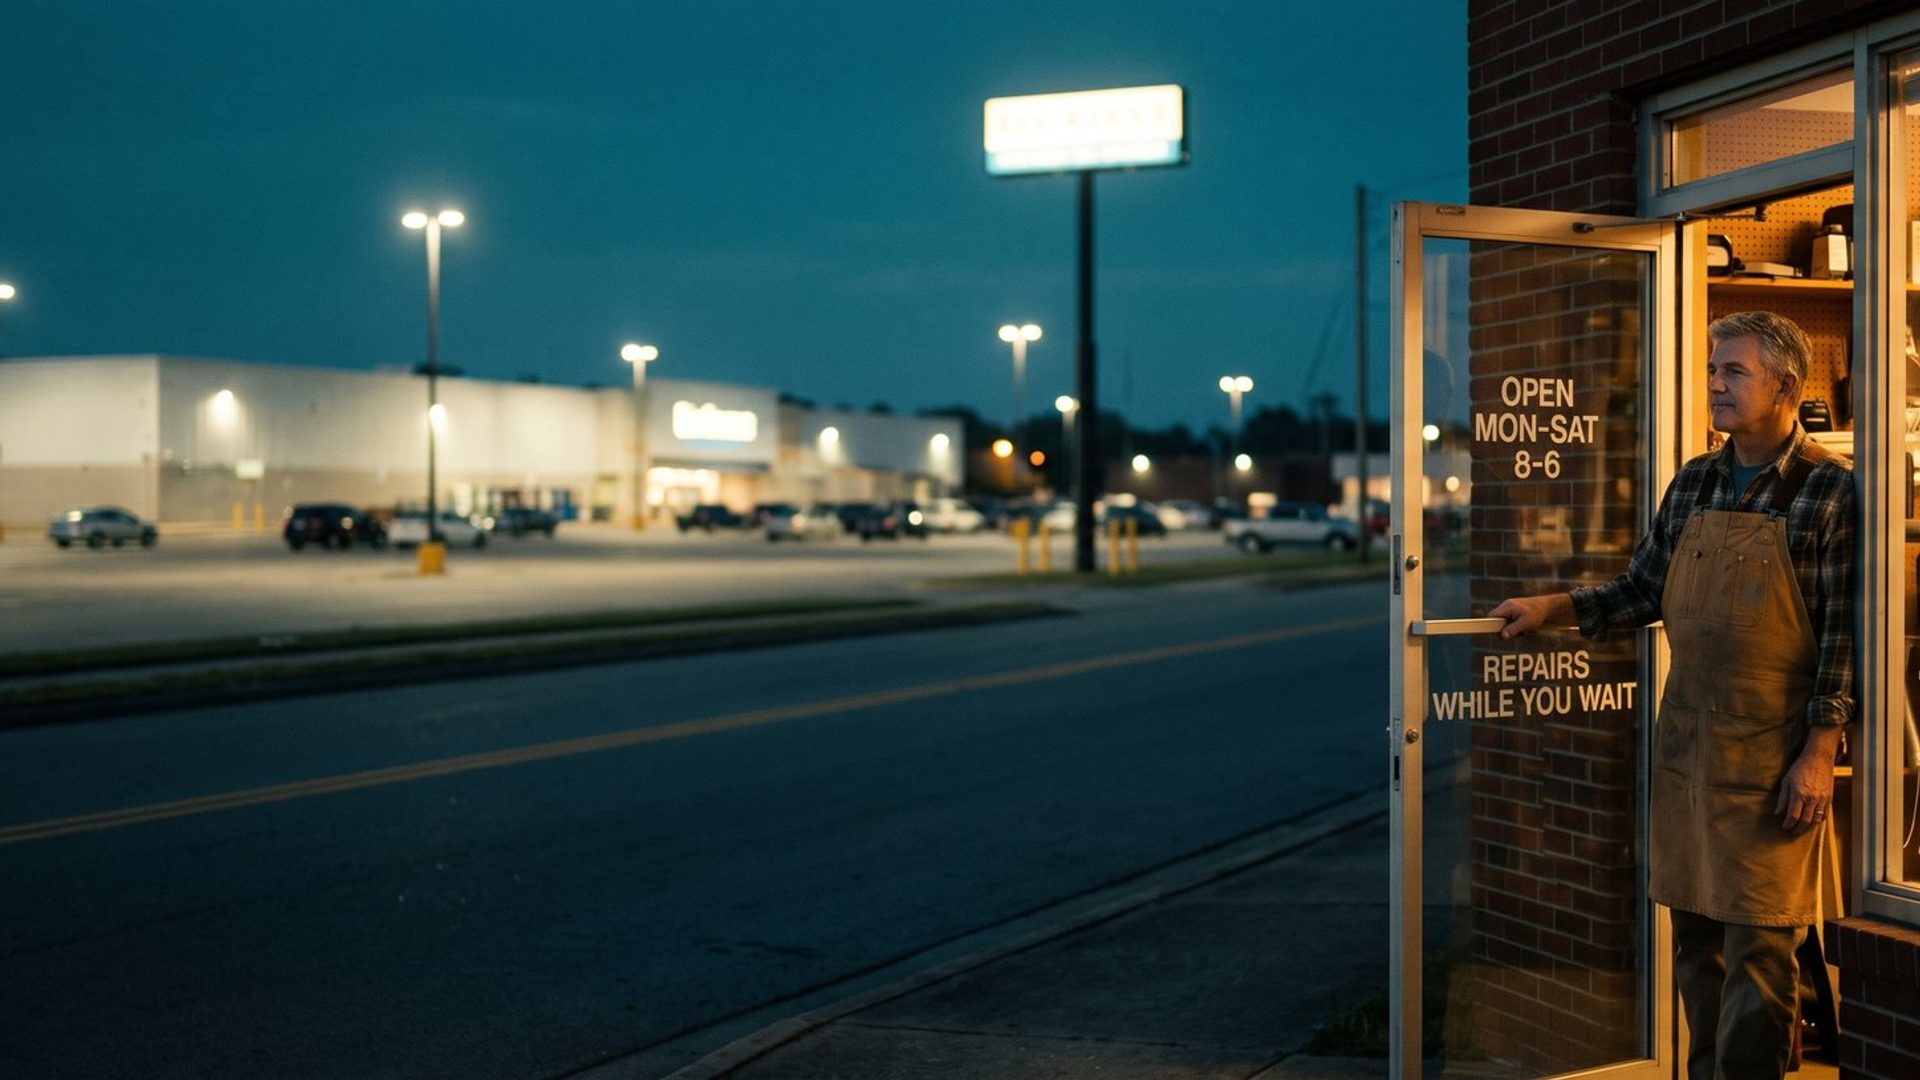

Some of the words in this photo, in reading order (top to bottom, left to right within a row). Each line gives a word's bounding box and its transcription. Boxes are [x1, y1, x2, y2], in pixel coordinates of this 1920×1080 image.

[1501, 376, 1574, 407] OPEN
[1475, 413, 1599, 444] MON-SAT
[1514, 450, 1561, 479] 8-6
[1484, 650, 1590, 684] REPAIRS
[1433, 688, 1514, 721] WHILE
[1520, 686, 1571, 716] YOU
[1579, 682, 1637, 712] WAIT
